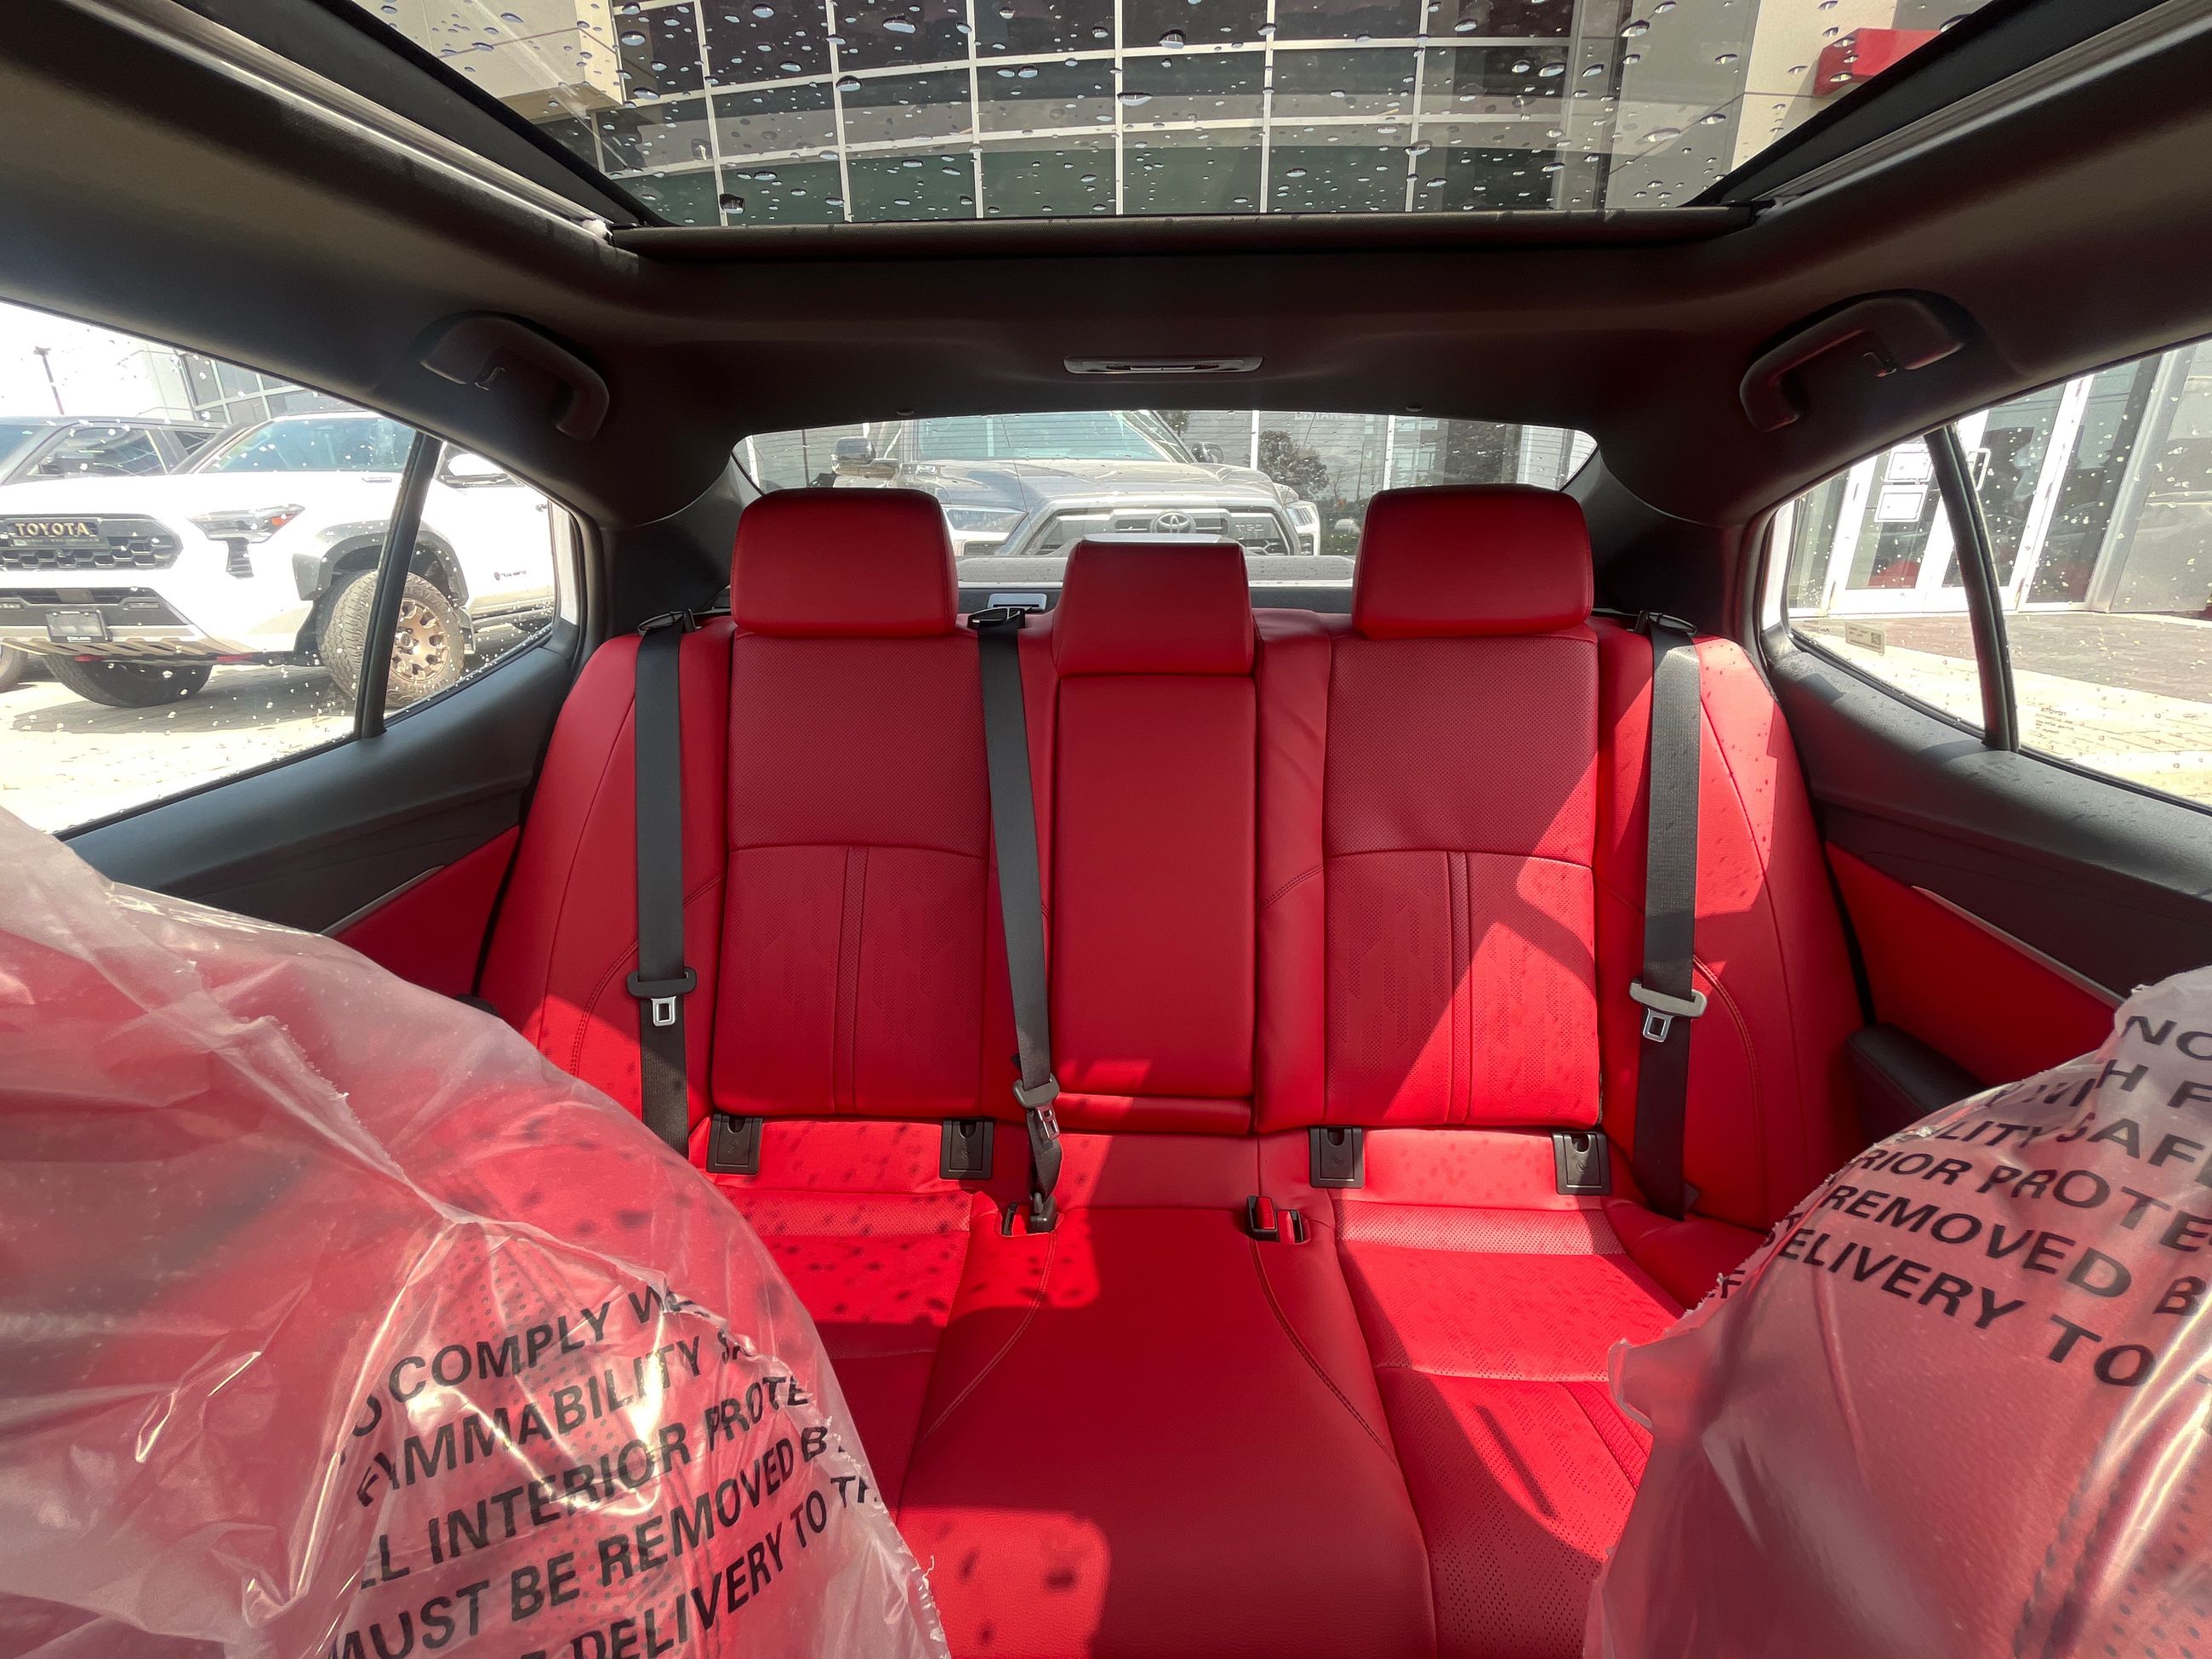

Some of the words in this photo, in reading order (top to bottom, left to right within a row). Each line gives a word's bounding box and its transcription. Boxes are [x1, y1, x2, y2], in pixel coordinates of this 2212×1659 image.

[15, 522, 90, 536] TOYOTA
[1933, 1120, 2045, 1149] LITY
[1821, 1185, 2132, 1298] REMOVED
[1978, 1165, 2212, 1251] PROTE
[389, 1302, 610, 1402] COMPLY
[1779, 1229, 2026, 1329] ELIVERY
[2047, 1314, 2156, 1387] TO
[428, 1427, 688, 1564] INTERIOR
[705, 1376, 810, 1455] PROTE
[511, 1552, 580, 1621] BE
[599, 1443, 794, 1587] REMOVED
[571, 1542, 784, 1659] DELIVERY
[790, 1490, 828, 1547] TO
